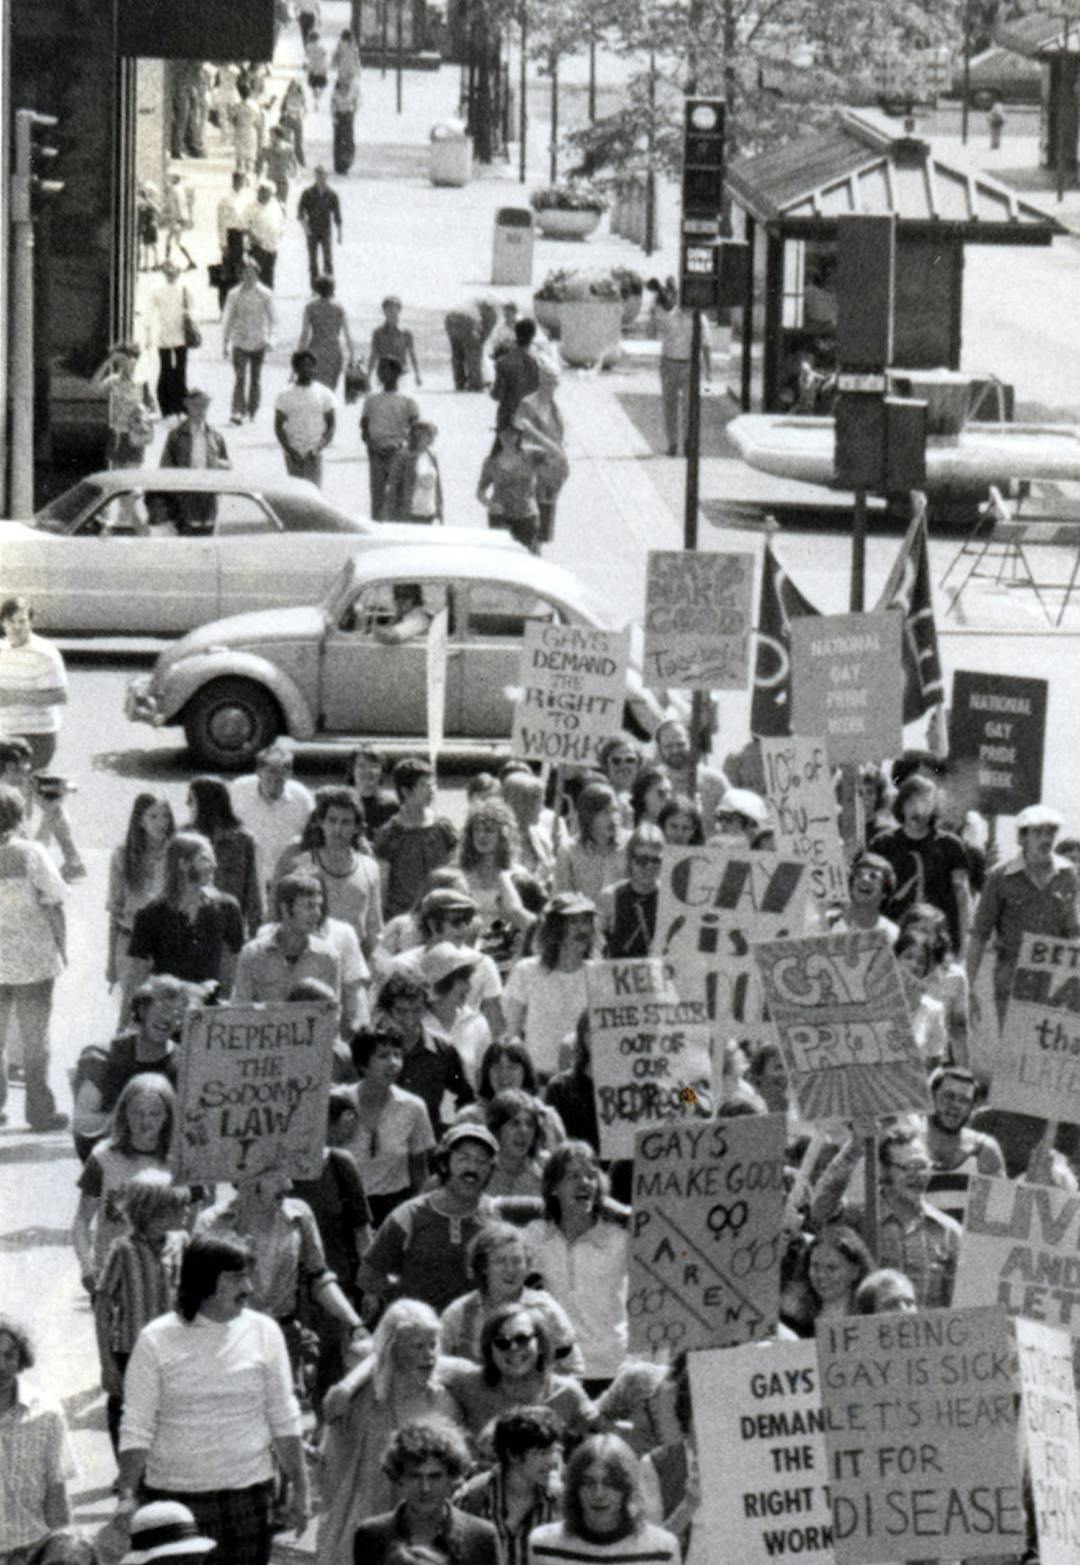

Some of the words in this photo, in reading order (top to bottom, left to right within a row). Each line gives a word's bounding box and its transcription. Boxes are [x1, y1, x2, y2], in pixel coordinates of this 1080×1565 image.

[532, 649, 617, 676] DEMAND
[968, 693, 1032, 715] NATIONAL
[547, 711, 580, 730] TO
[984, 720, 1014, 739] GAY
[671, 855, 805, 914] GAY
[772, 947, 884, 1008] GAY
[594, 1005, 640, 1028] THE
[619, 1033, 657, 1055] OUT
[660, 1032, 685, 1054] OF
[237, 1056, 283, 1077] THE
[633, 1057, 671, 1078] OUR
[220, 1104, 298, 1137] LAW
[641, 1126, 728, 1160] GAYS
[637, 1166, 721, 1197] MAKE
[829, 1325, 859, 1353] IF
[878, 1318, 968, 1349] BEING
[751, 1367, 815, 1399] GAYS
[826, 1359, 892, 1389] GAY
[906, 1357, 929, 1386] IS
[941, 1351, 1011, 1385] SICK
[740, 1408, 825, 1440] DEMAN
[826, 1401, 922, 1431] LET'S
[935, 1394, 1014, 1428] HEAR
[771, 1445, 814, 1472] THE
[834, 1449, 864, 1480] IT
[878, 1444, 944, 1478] FOR
[743, 1487, 813, 1519] RIGHT
[833, 1486, 1023, 1540] DISEASE
